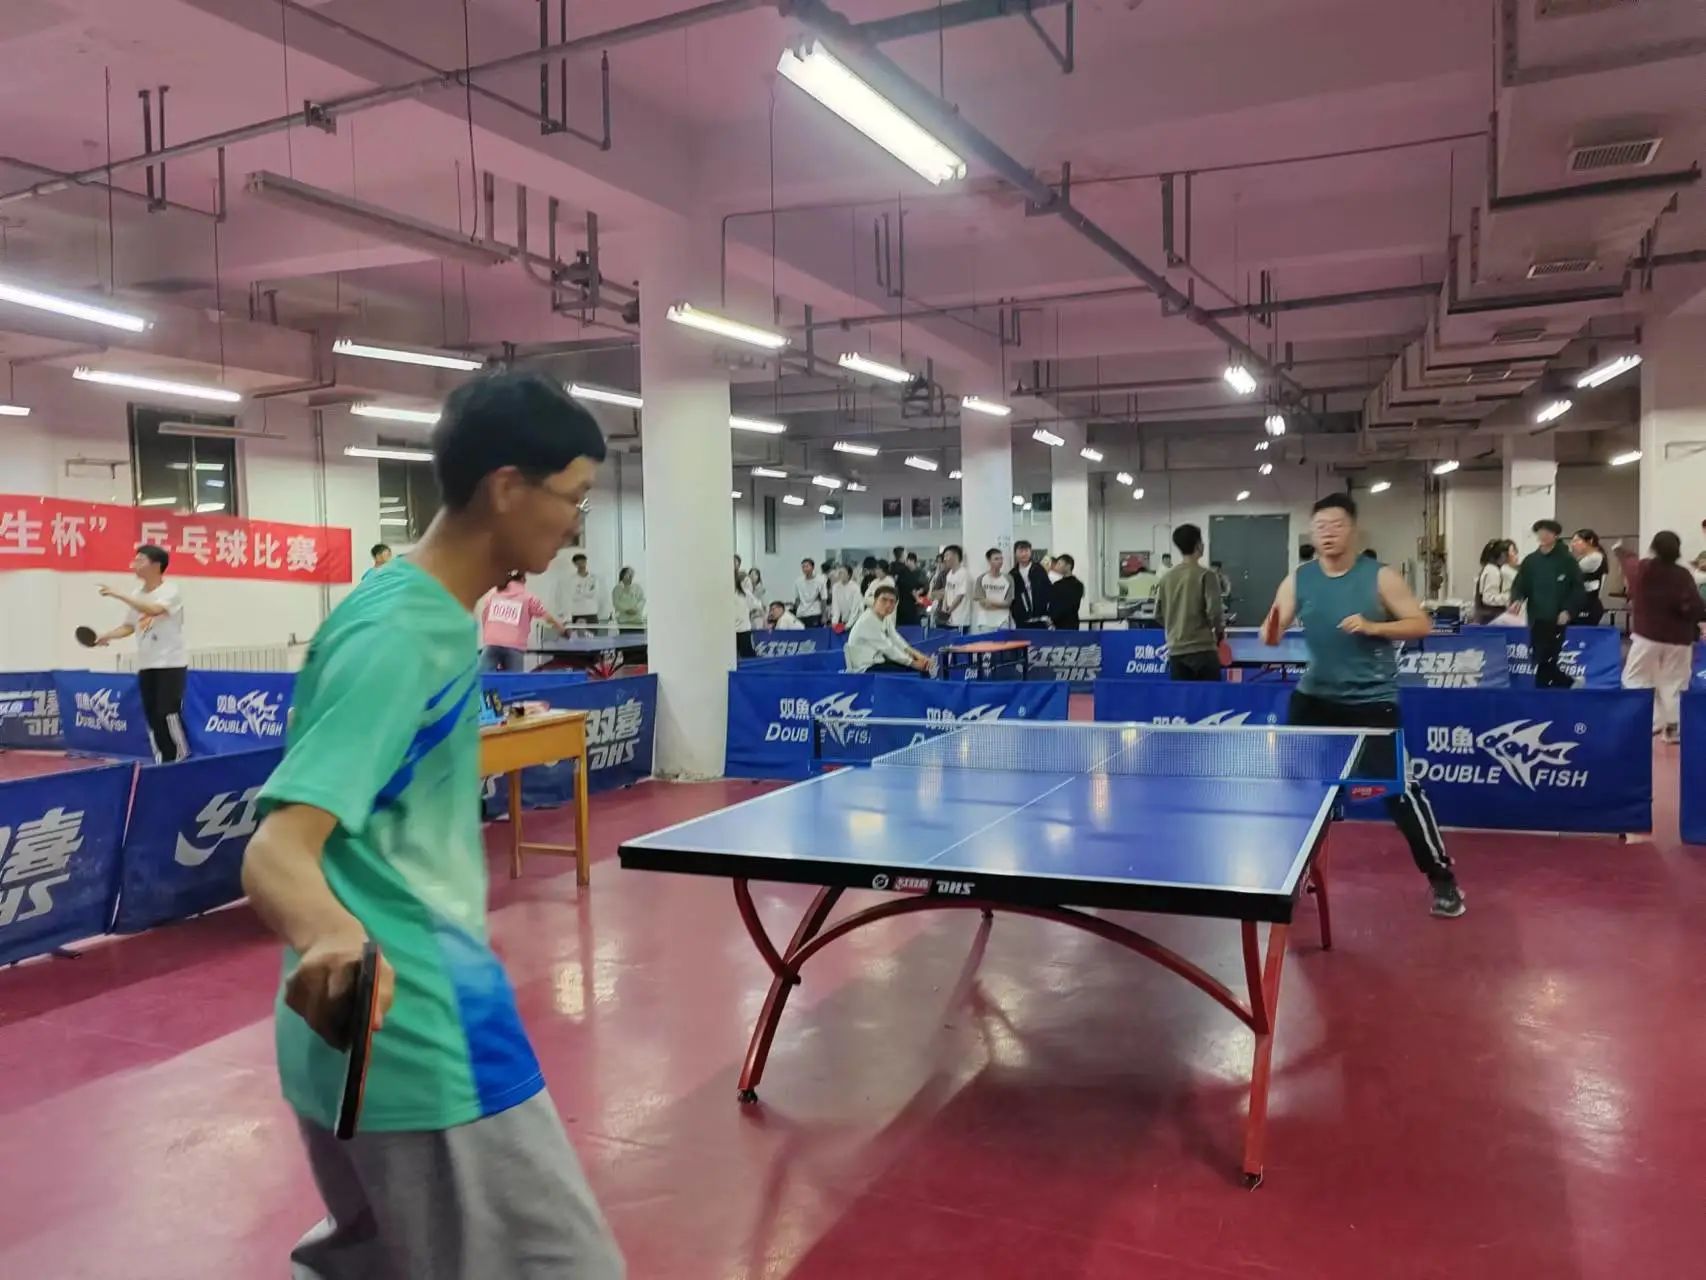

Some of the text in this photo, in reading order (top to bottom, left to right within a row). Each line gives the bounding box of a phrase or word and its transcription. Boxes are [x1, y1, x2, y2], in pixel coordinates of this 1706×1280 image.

[589, 738, 640, 770] DHS
[1409, 757, 1588, 788] DOUBLE FISH
[935, 880, 975, 895] DHS
